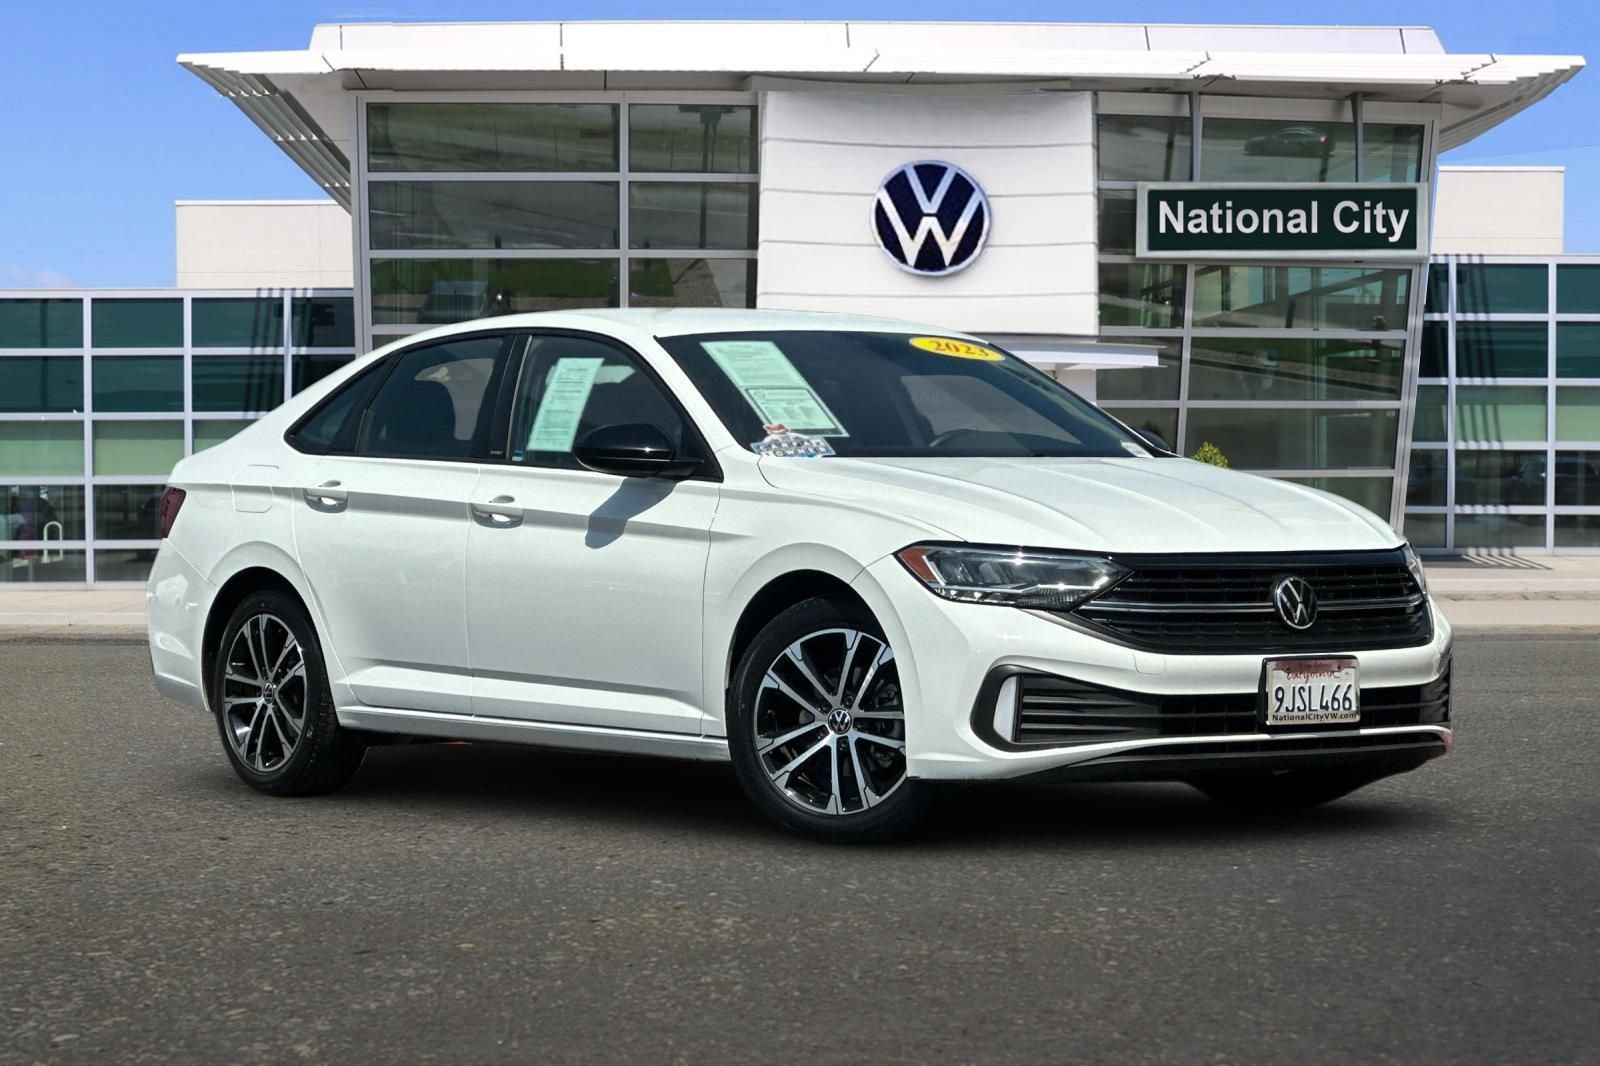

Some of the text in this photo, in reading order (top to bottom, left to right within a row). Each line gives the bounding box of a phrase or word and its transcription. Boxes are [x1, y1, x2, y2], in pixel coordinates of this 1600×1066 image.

[1158, 199, 1410, 242] National City
[928, 341, 989, 357] 2023
[1274, 684, 1352, 713] 9JSL466
[1272, 711, 1357, 722] NationalCityVW.com
